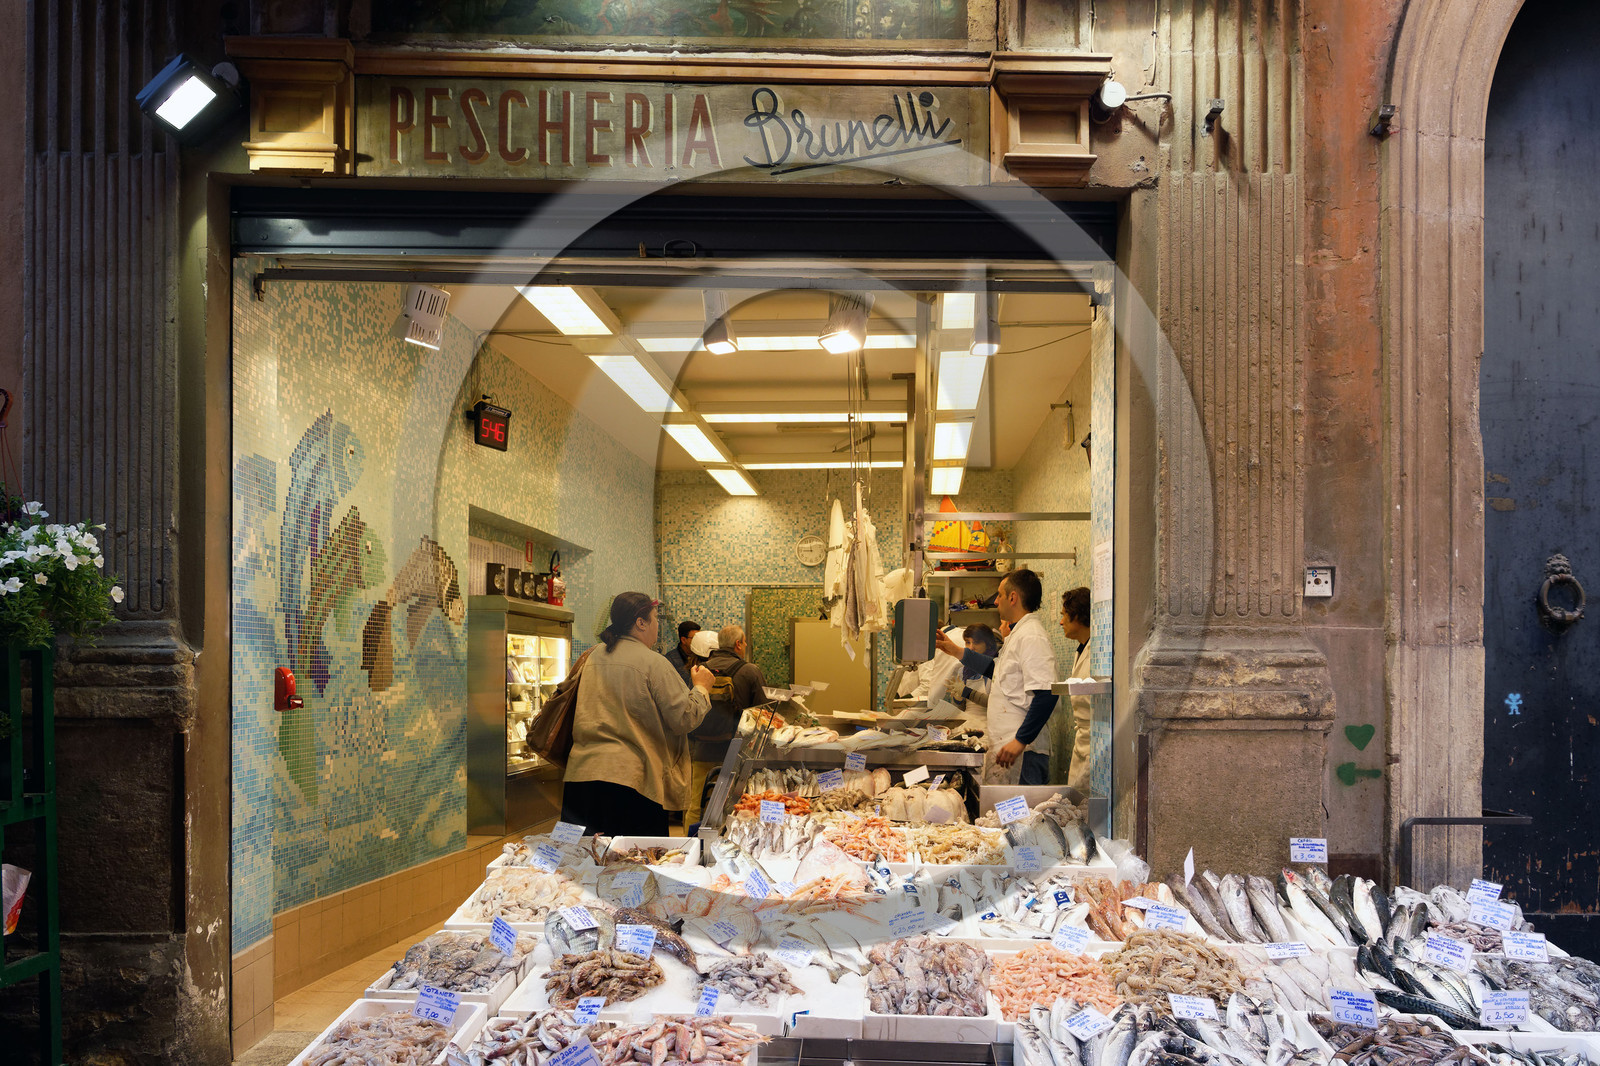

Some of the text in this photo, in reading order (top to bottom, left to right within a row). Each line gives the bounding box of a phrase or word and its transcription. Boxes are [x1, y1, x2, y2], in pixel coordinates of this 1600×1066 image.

[390, 87, 955, 170] PESCHERIA Brunelli
[1344, 1009, 1363, 1021] 6,00
[1494, 1011, 1515, 1021] 2,50
